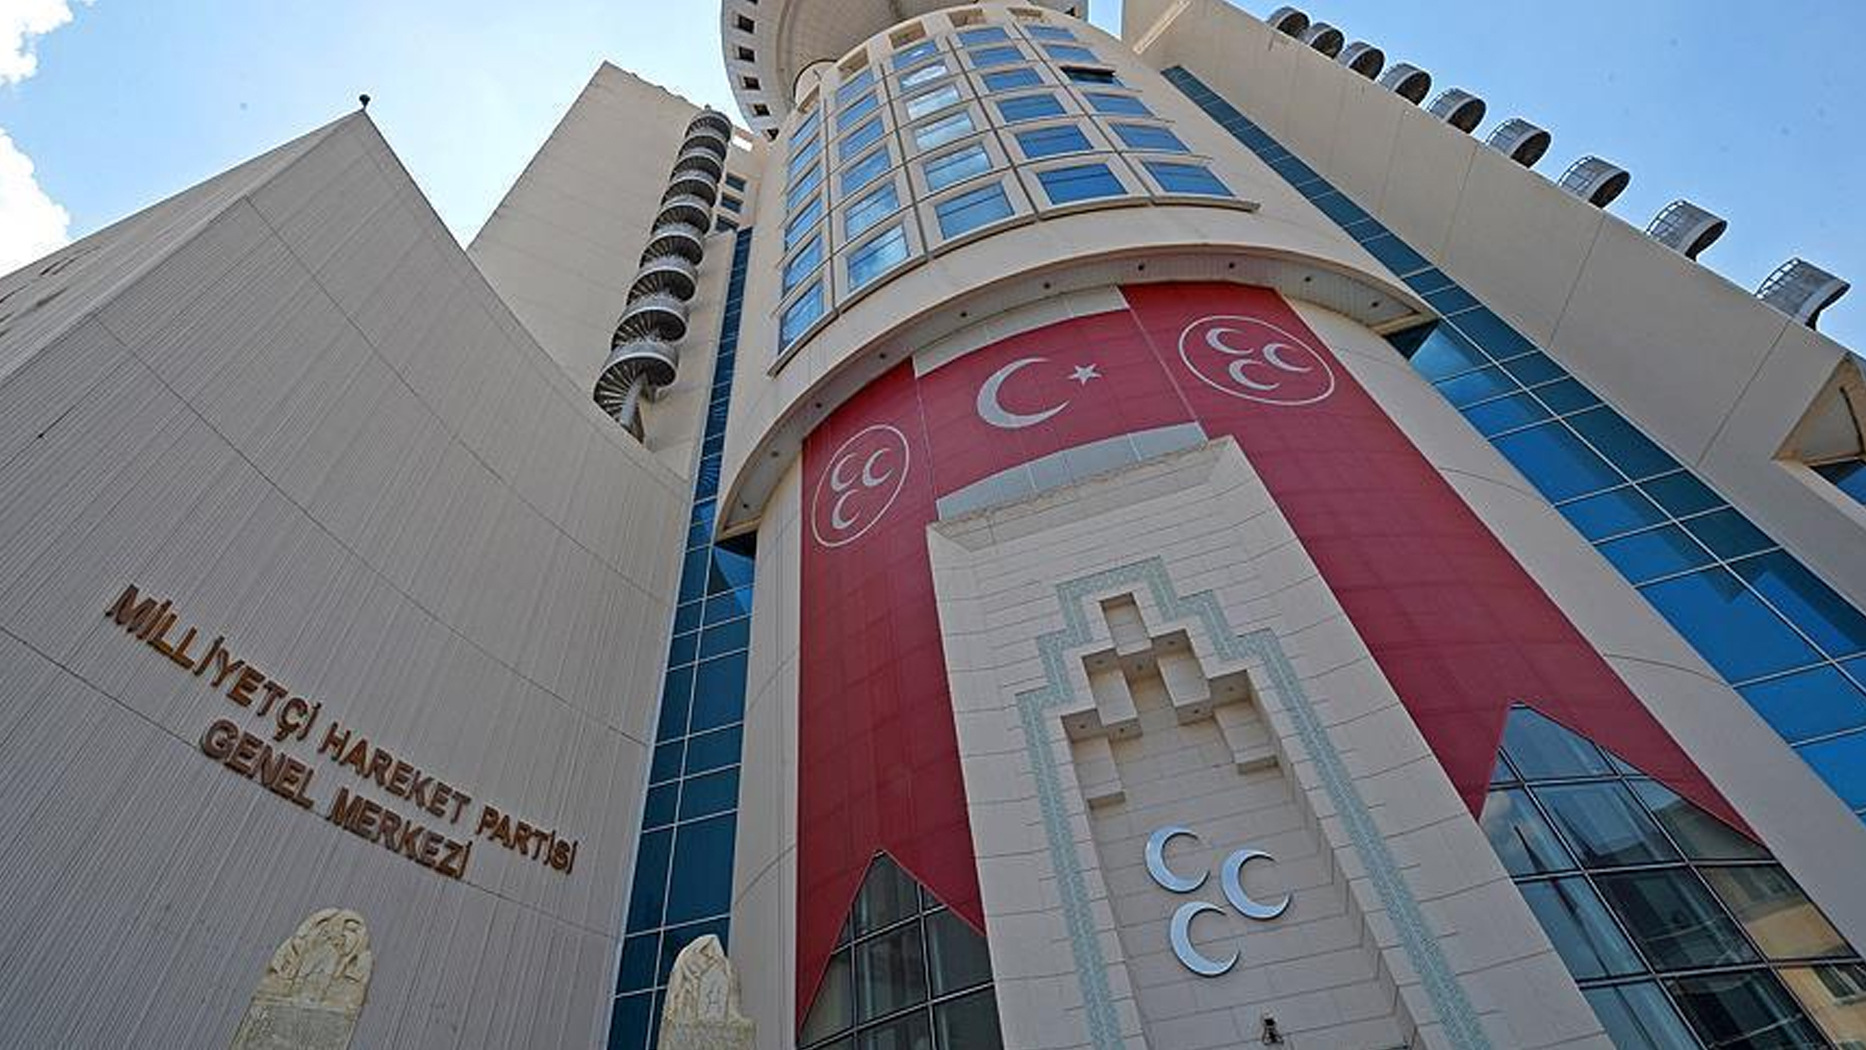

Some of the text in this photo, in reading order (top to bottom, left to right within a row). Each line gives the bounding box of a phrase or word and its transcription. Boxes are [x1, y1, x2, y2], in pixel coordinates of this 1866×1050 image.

[105, 584, 580, 875] MİLLİYETÇİ HAREKET PARTİSİ
[200, 719, 473, 879] GENEL MERKEZİ
